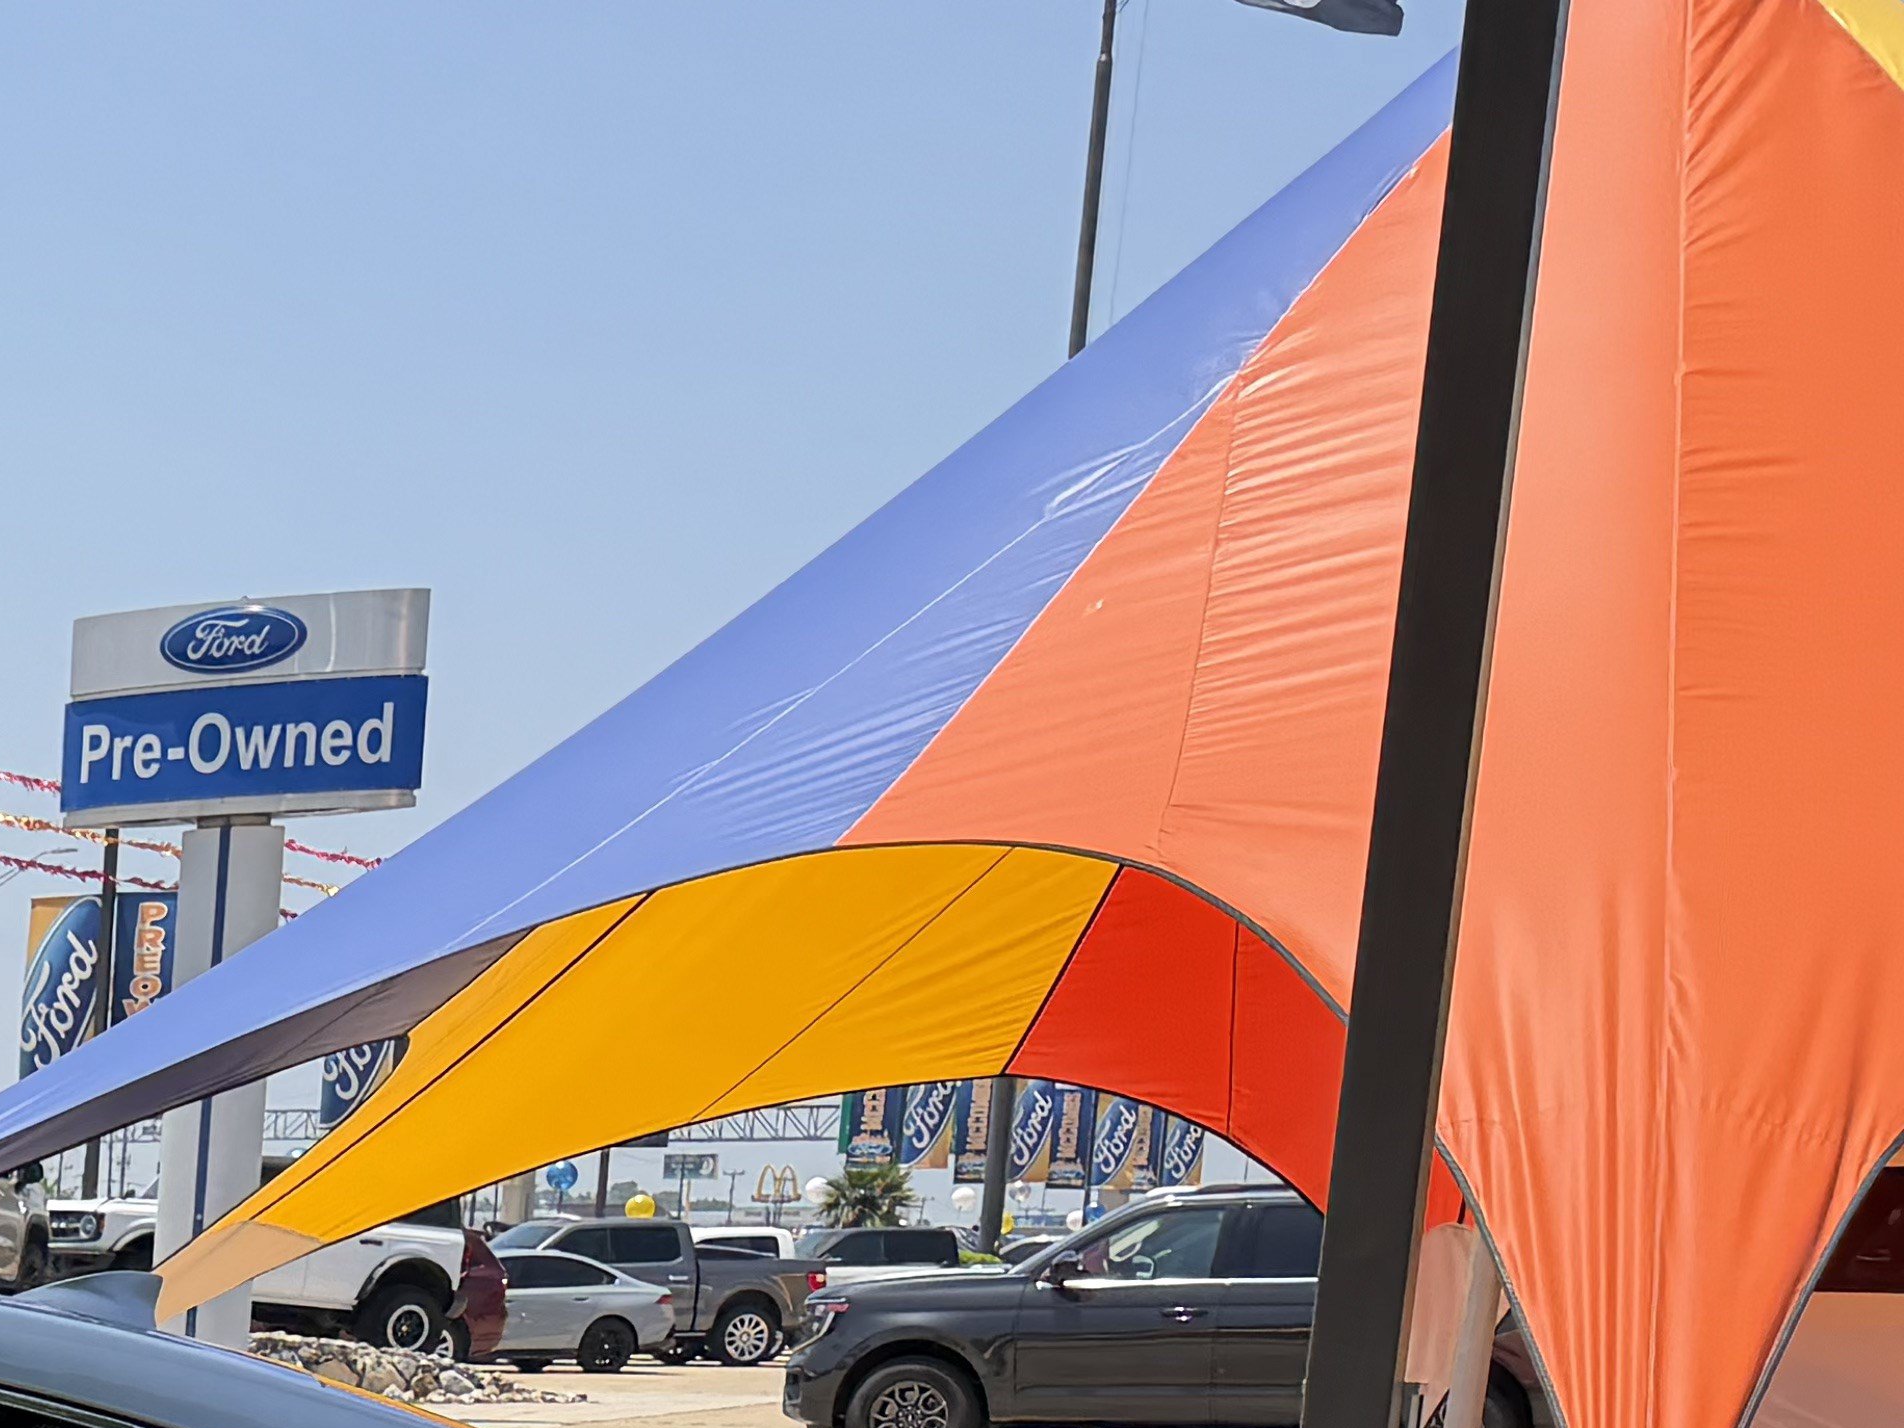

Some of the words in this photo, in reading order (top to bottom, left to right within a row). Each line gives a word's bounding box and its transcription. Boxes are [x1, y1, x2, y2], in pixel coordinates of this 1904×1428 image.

[187, 619, 269, 659] Ford
[79, 702, 395, 784] Pre-Owned
[122, 902, 169, 1018] PREO
[20, 929, 98, 1069] Ford
[323, 1044, 372, 1101] Fo
[1010, 1090, 1053, 1166] Ford
[1093, 1104, 1137, 1174] Ford
